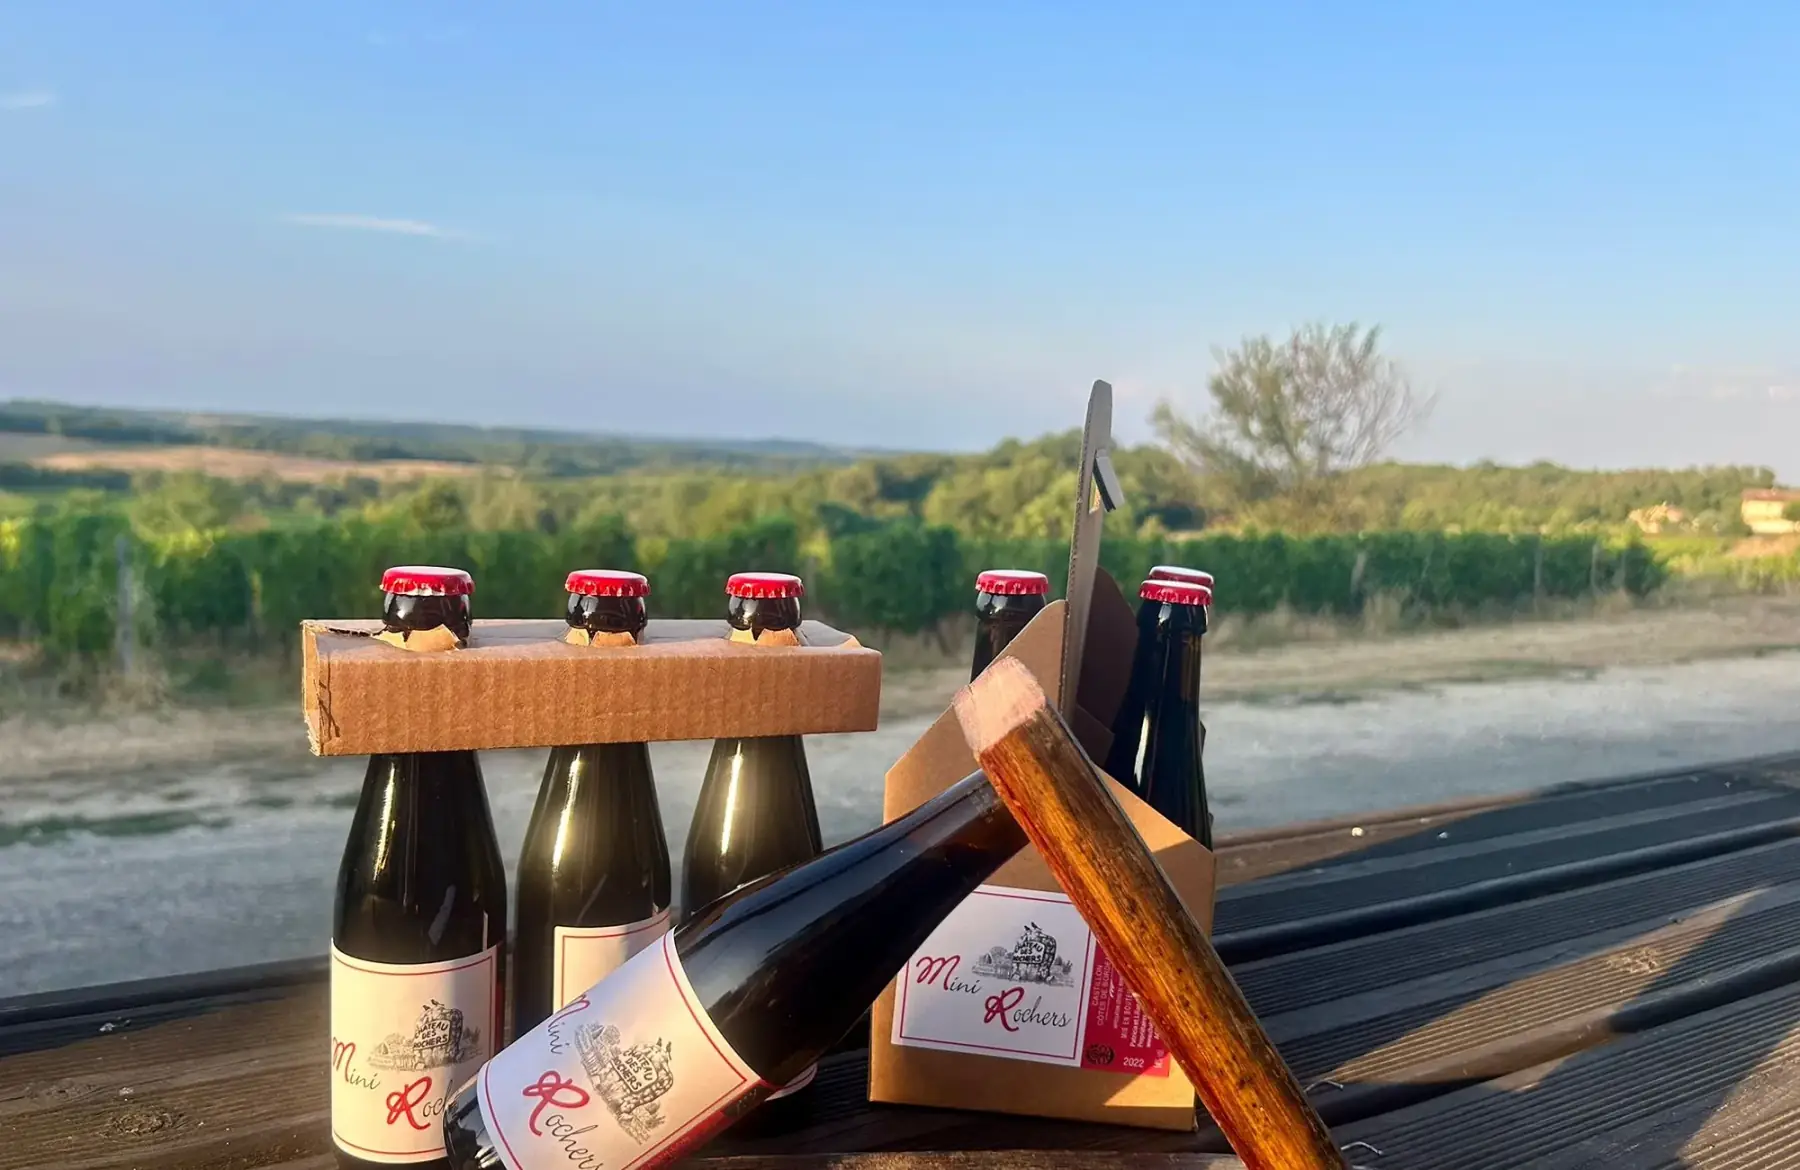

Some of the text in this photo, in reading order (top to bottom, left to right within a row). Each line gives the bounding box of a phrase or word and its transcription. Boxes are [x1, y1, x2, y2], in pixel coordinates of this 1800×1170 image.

[916, 954, 982, 994] Mini
[984, 986, 1072, 1032] Rochers
[413, 1034, 449, 1049] ROCHERS
[421, 1030, 437, 1039] DES
[333, 1037, 380, 1090] Mini
[625, 1058, 641, 1073] DES
[1123, 1056, 1145, 1068] 2022
[613, 1057, 643, 1091] ROCHERS
